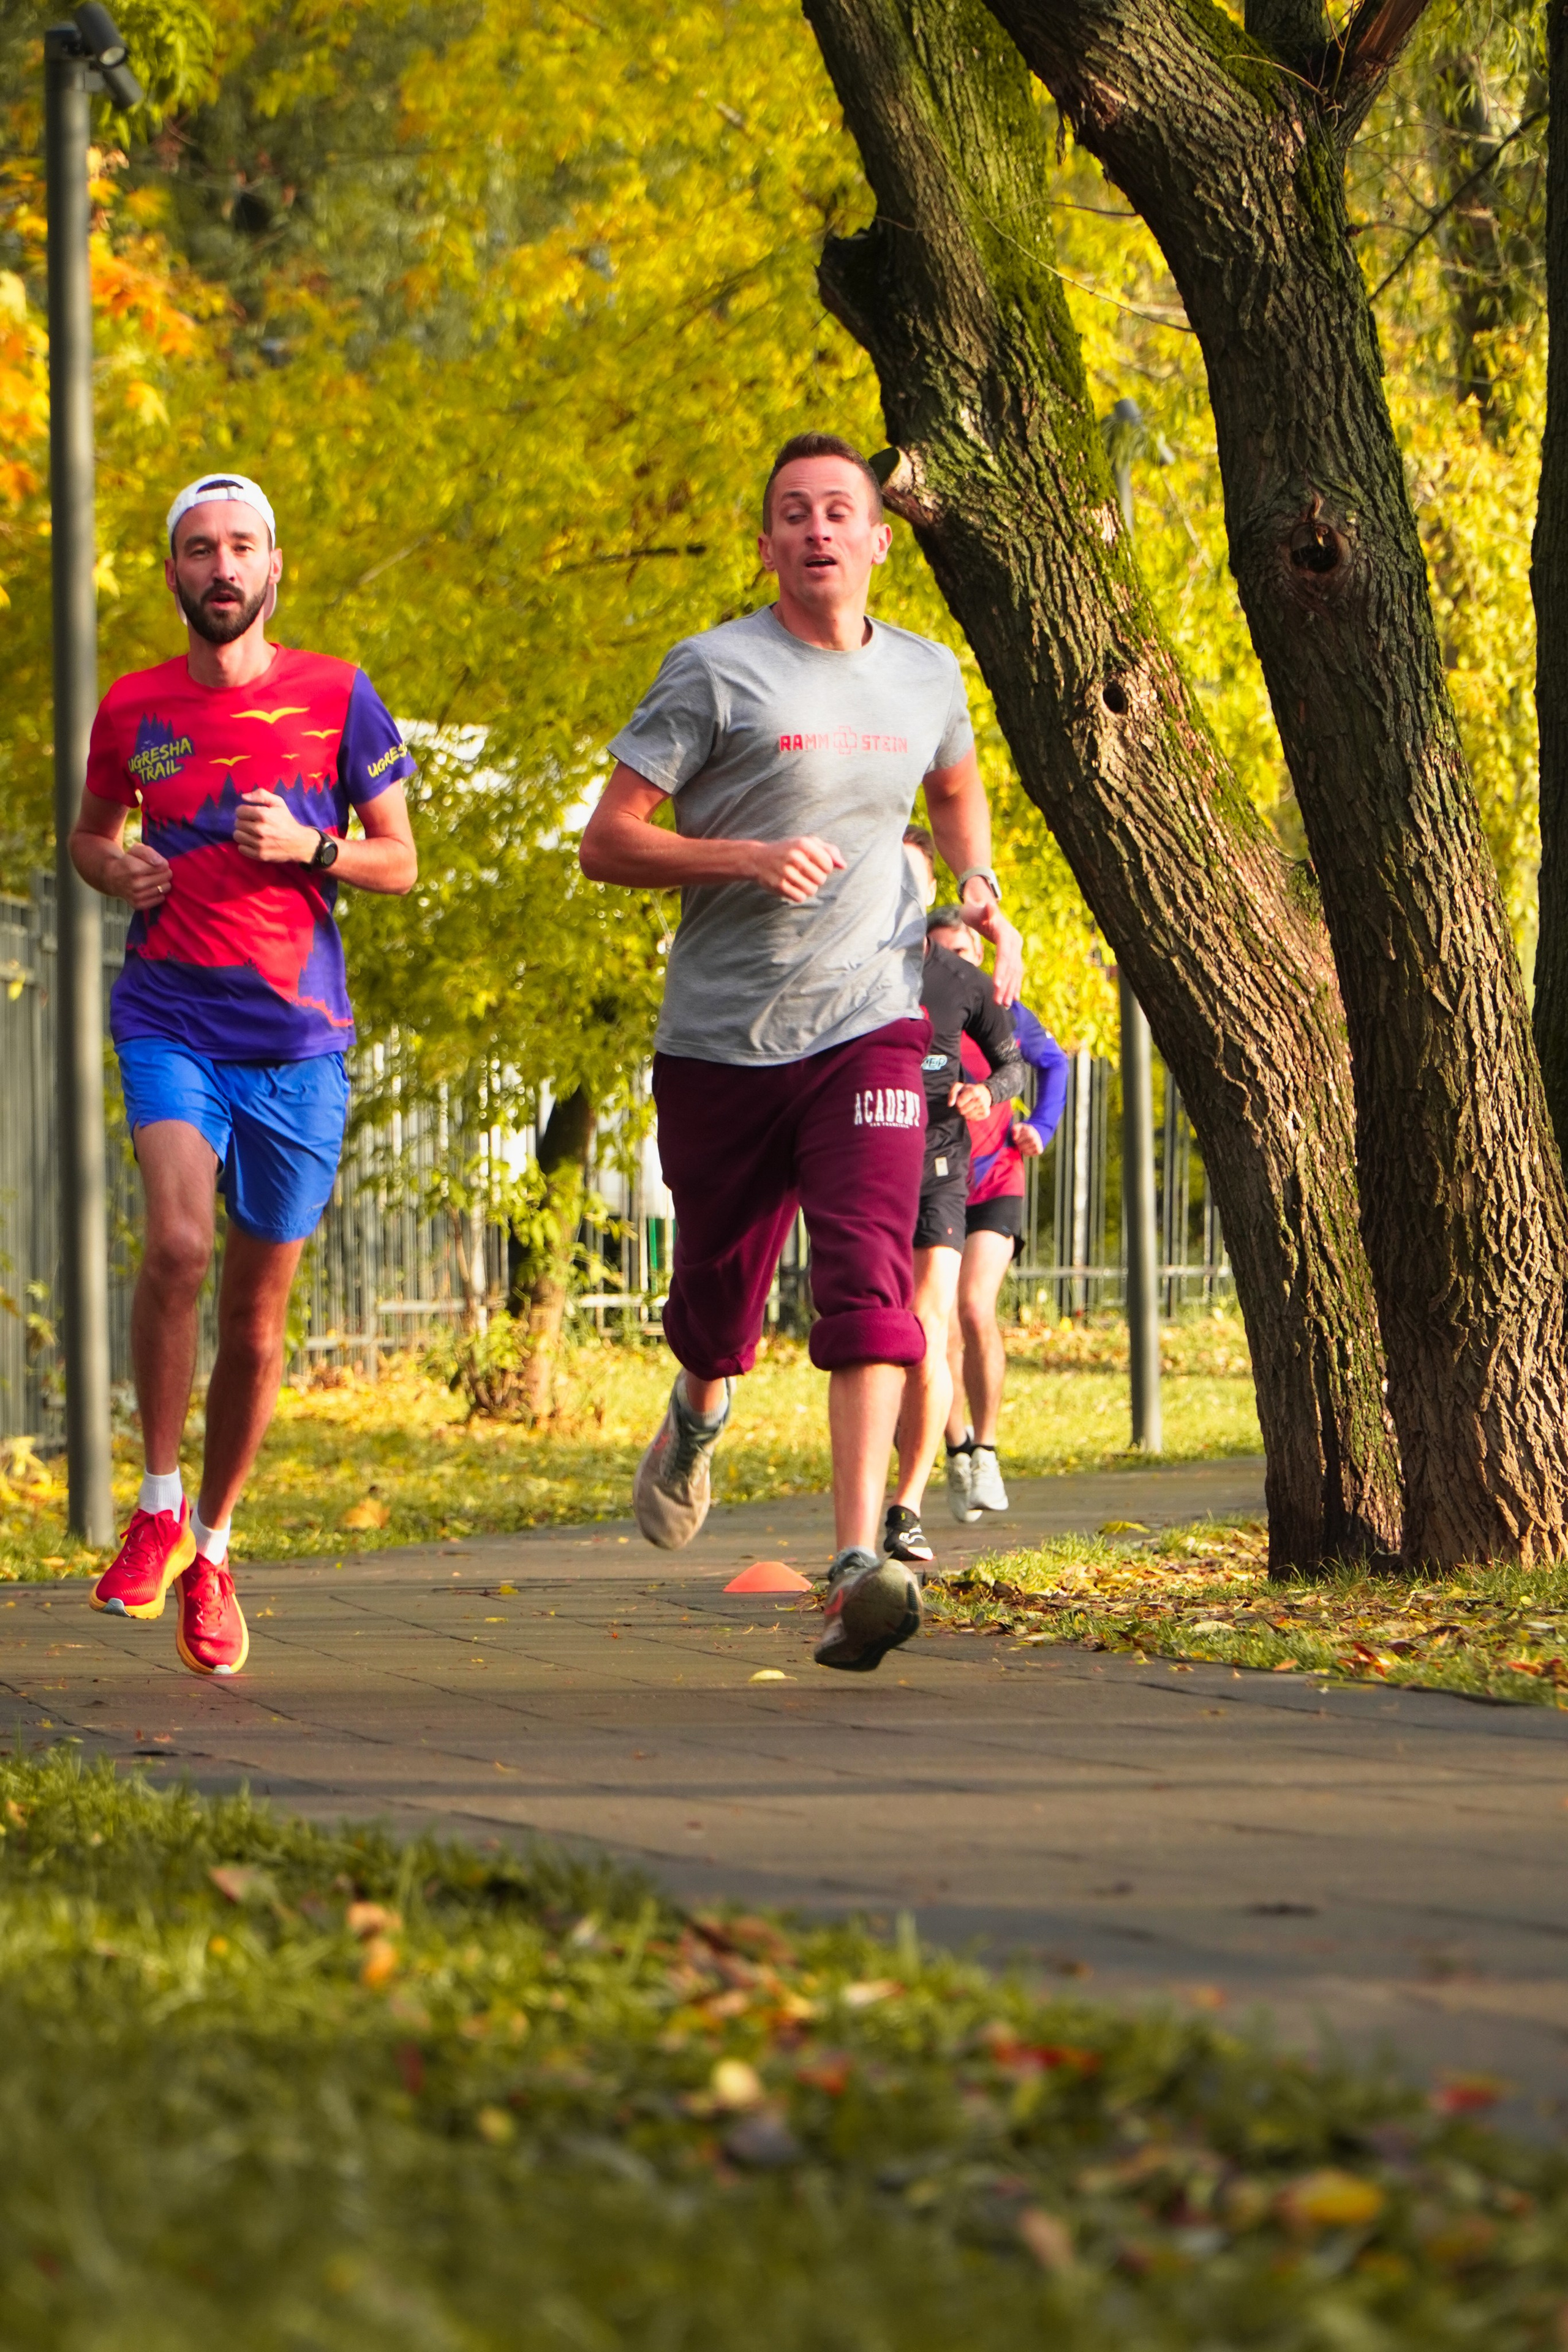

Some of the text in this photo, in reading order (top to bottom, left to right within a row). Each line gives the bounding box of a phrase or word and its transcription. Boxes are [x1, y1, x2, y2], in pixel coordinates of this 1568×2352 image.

[128, 737, 192, 772] UGRESHA
[780, 734, 907, 753] RAMM STEIN
[138, 760, 182, 785] TRAIL
[368, 743, 407, 777] UGRES
